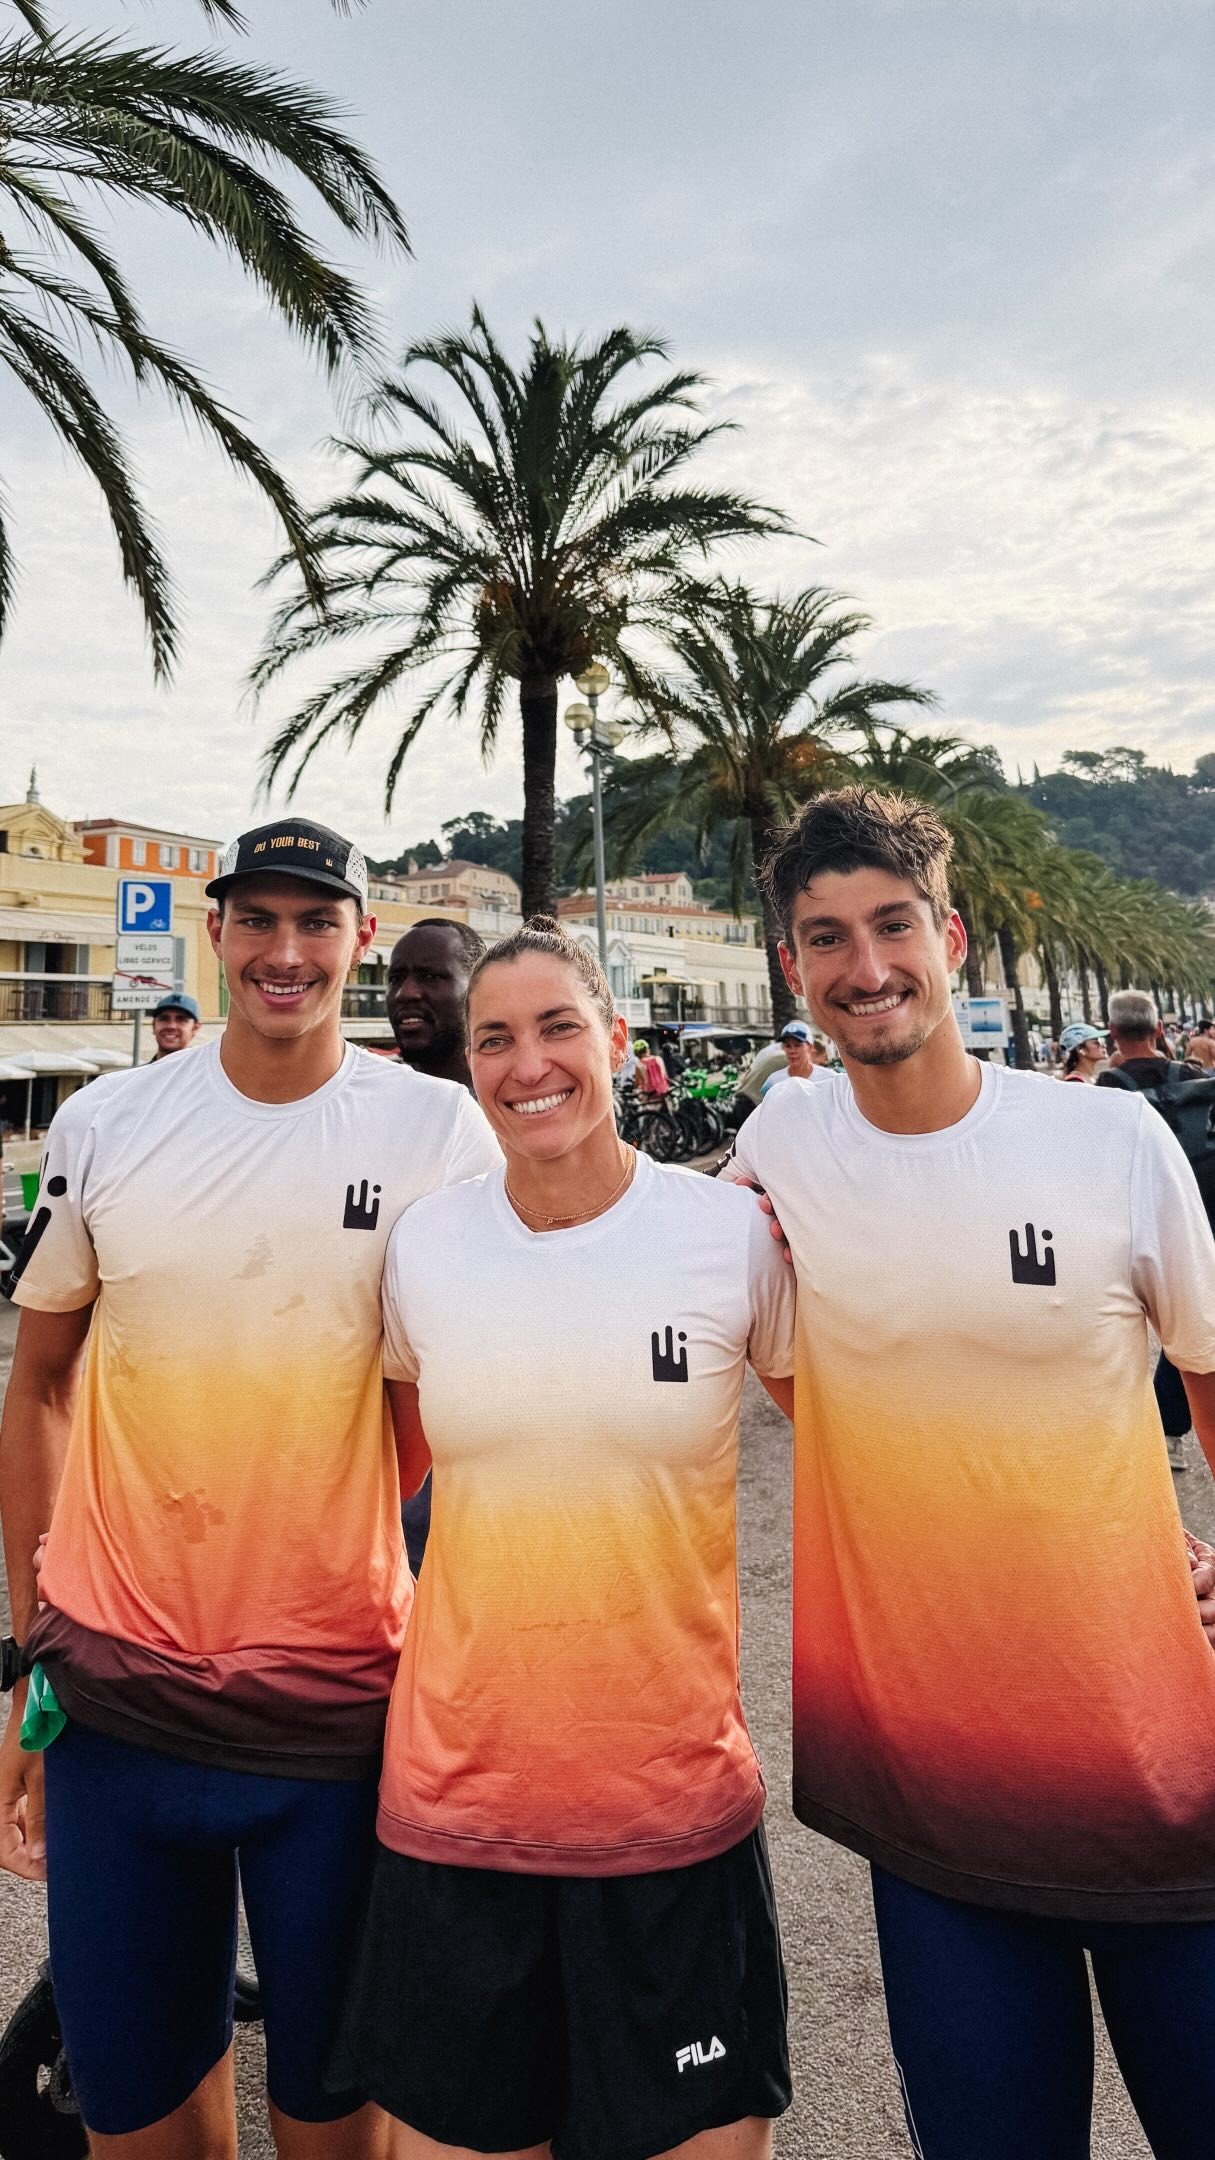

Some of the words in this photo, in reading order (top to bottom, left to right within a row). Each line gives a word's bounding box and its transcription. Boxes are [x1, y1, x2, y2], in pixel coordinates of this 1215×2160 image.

[270, 836, 295, 849] YOUR
[297, 837, 321, 851] BEST
[126, 883, 156, 925] P
[675, 2035, 727, 2073] FILA
